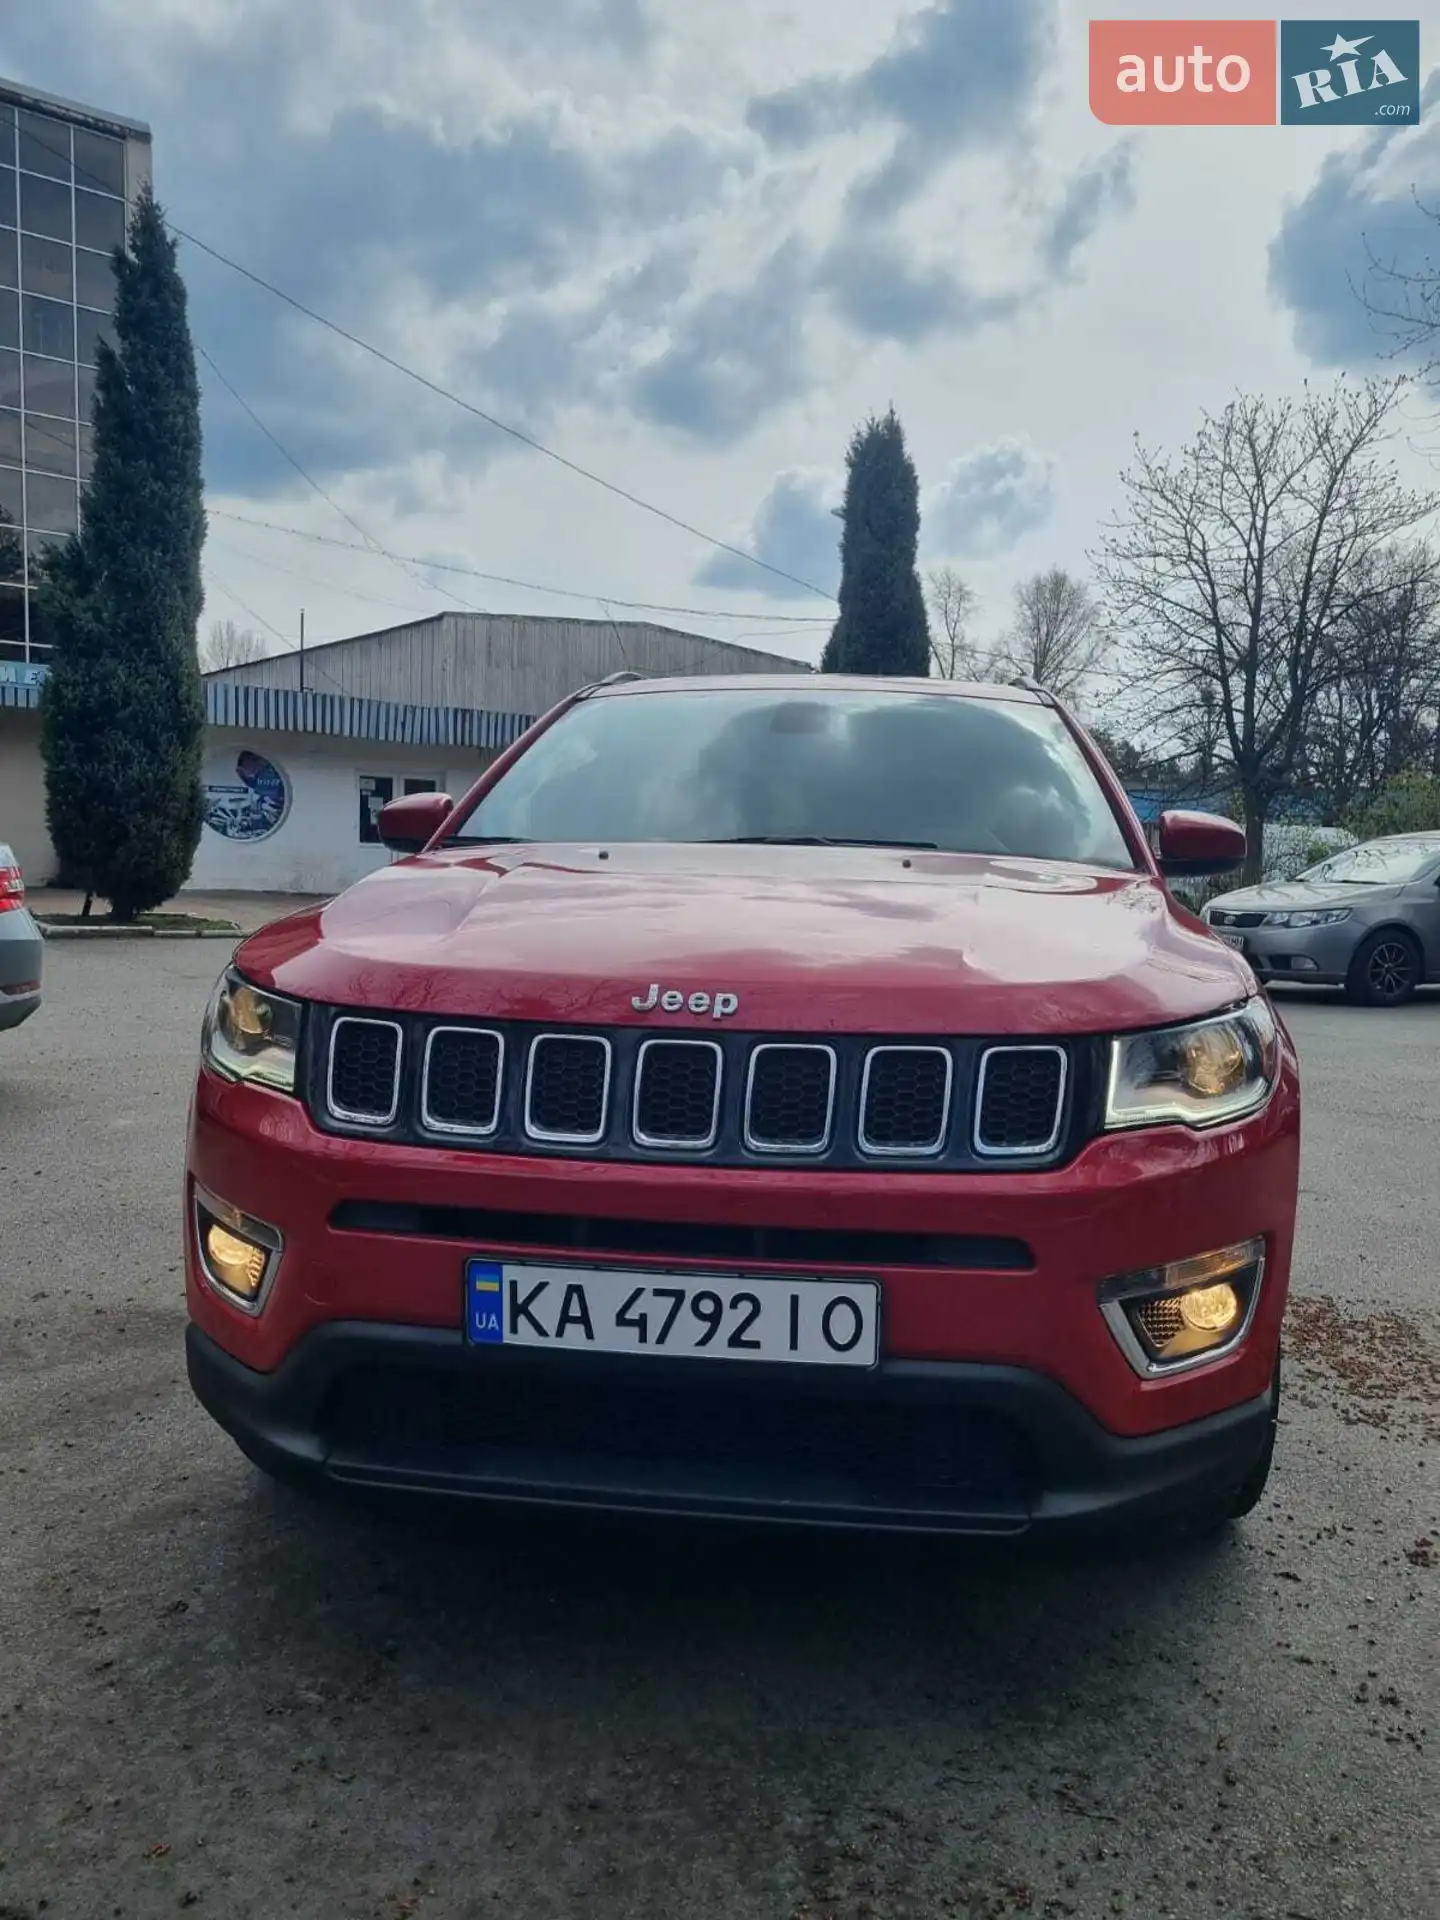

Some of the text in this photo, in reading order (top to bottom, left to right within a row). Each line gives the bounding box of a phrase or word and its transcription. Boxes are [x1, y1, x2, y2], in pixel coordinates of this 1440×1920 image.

[631, 983, 739, 1019] Jeep
[475, 1311, 500, 1331] UA
[508, 1279, 865, 1353] KA 4792 IO
